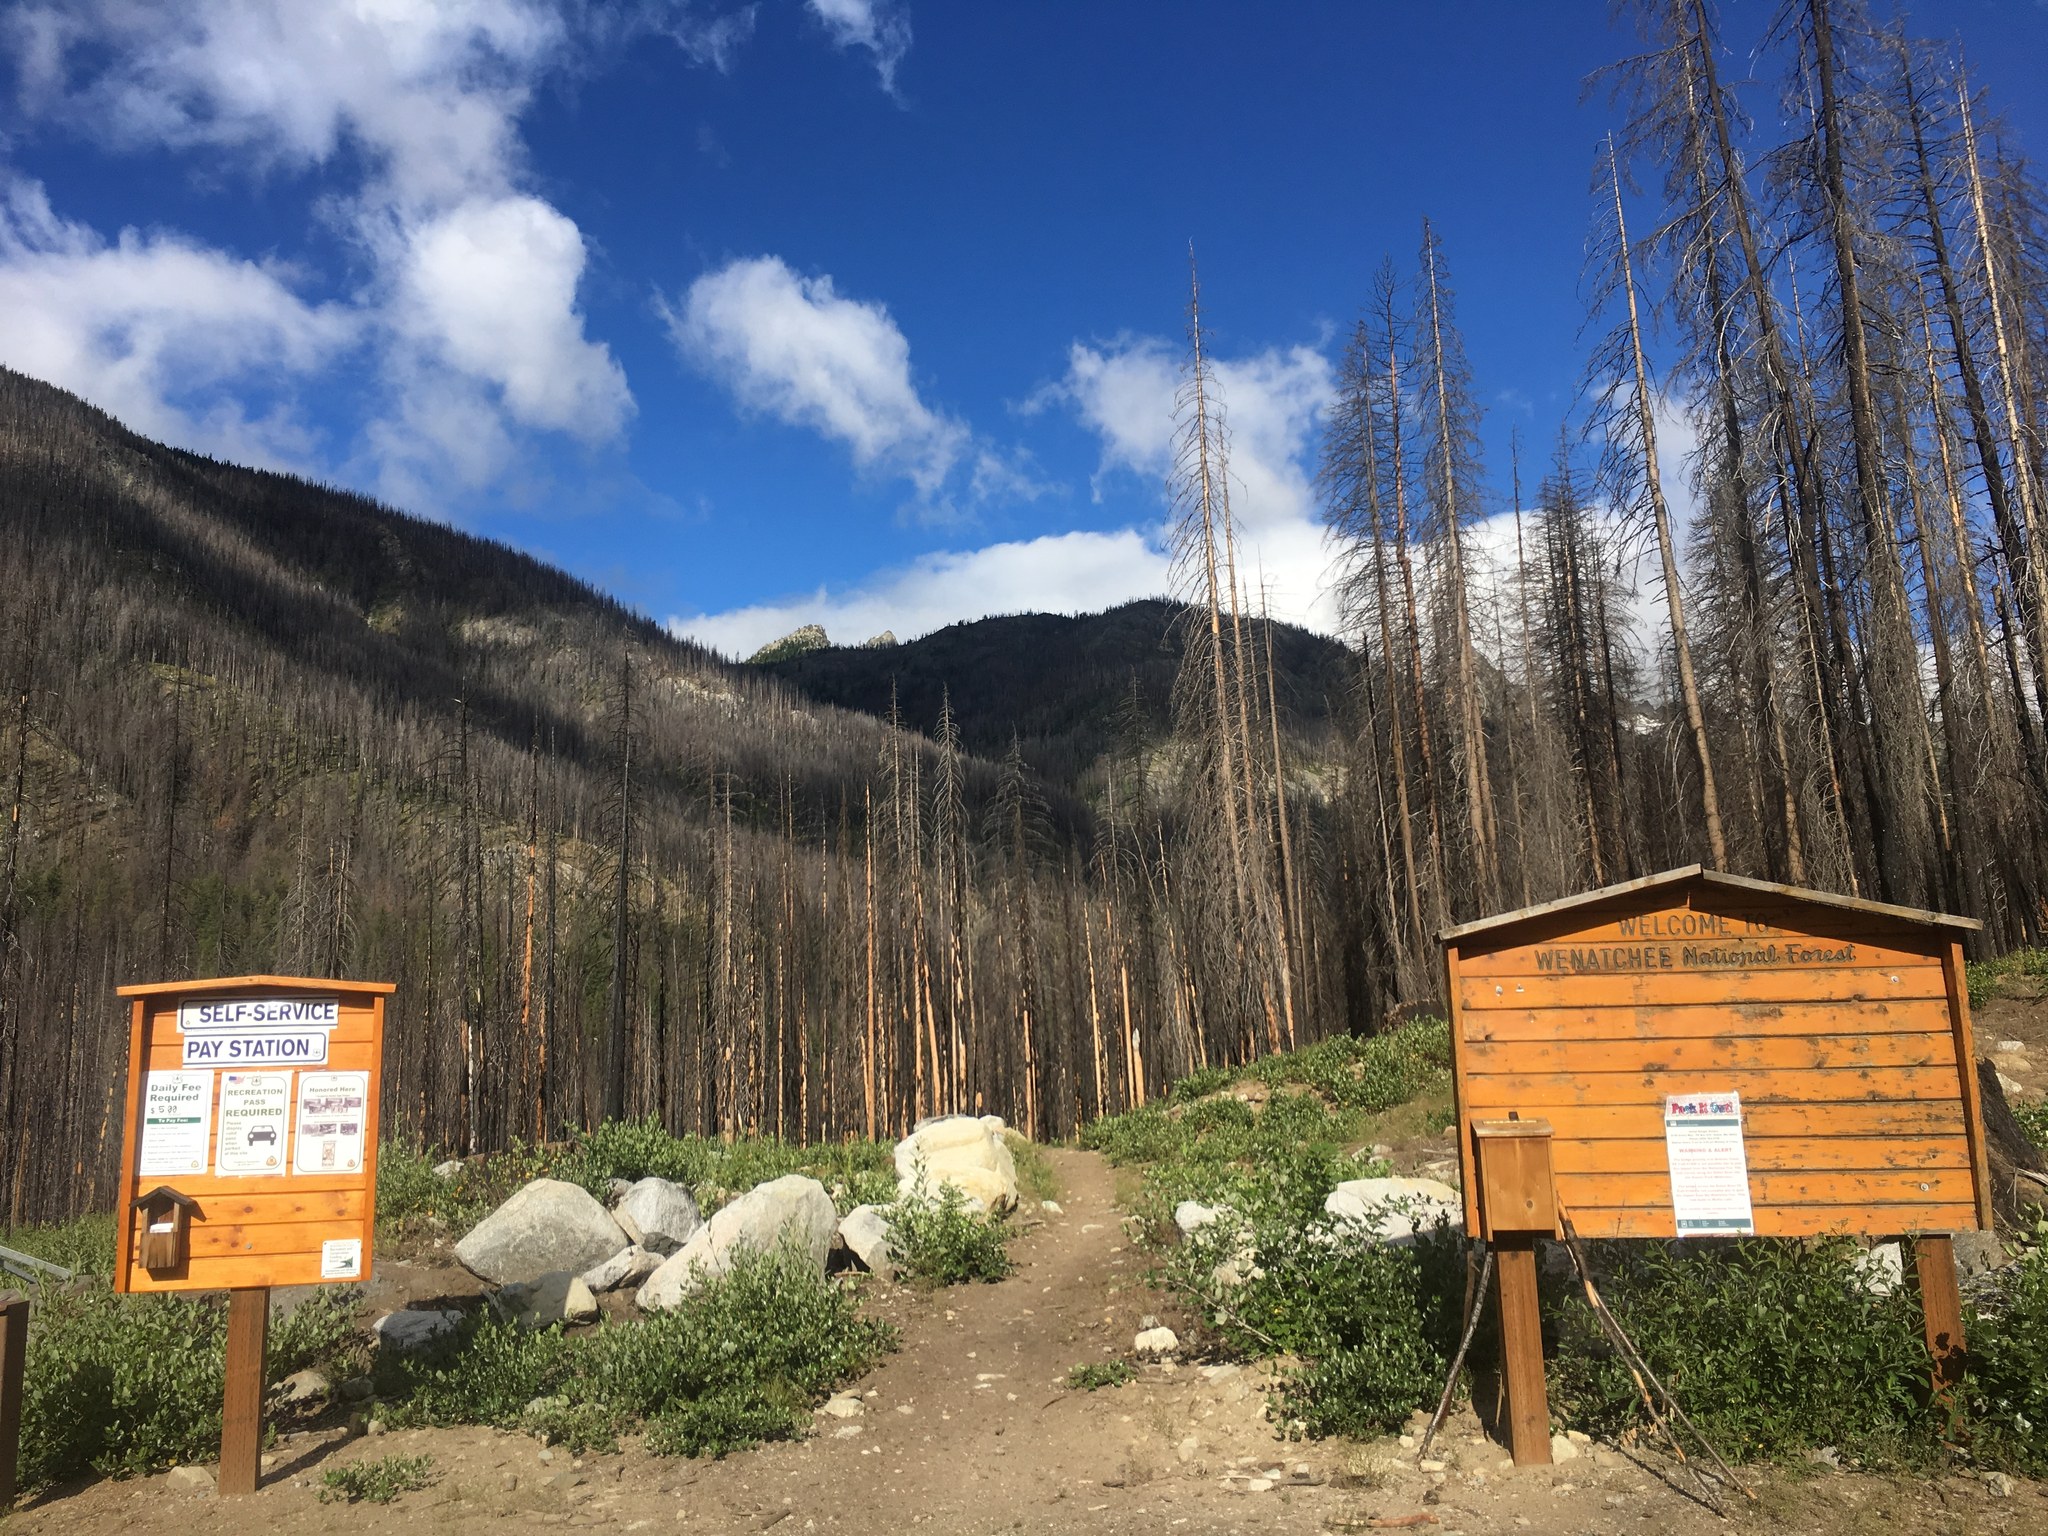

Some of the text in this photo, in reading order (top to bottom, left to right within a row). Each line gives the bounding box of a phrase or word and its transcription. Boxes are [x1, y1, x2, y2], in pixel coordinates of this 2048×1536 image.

[1618, 913, 1732, 938] WELCOME
[1534, 943, 1857, 972] WENATCHEE National Forest
[199, 1001, 335, 1023] SELF-SERVICE
[187, 1038, 310, 1059] PAY STATION
[151, 1083, 202, 1093] Daily Fee
[228, 1088, 283, 1096] RECREATION
[150, 1094, 199, 1103] Required
[226, 1108, 283, 1117] REQUIRED
